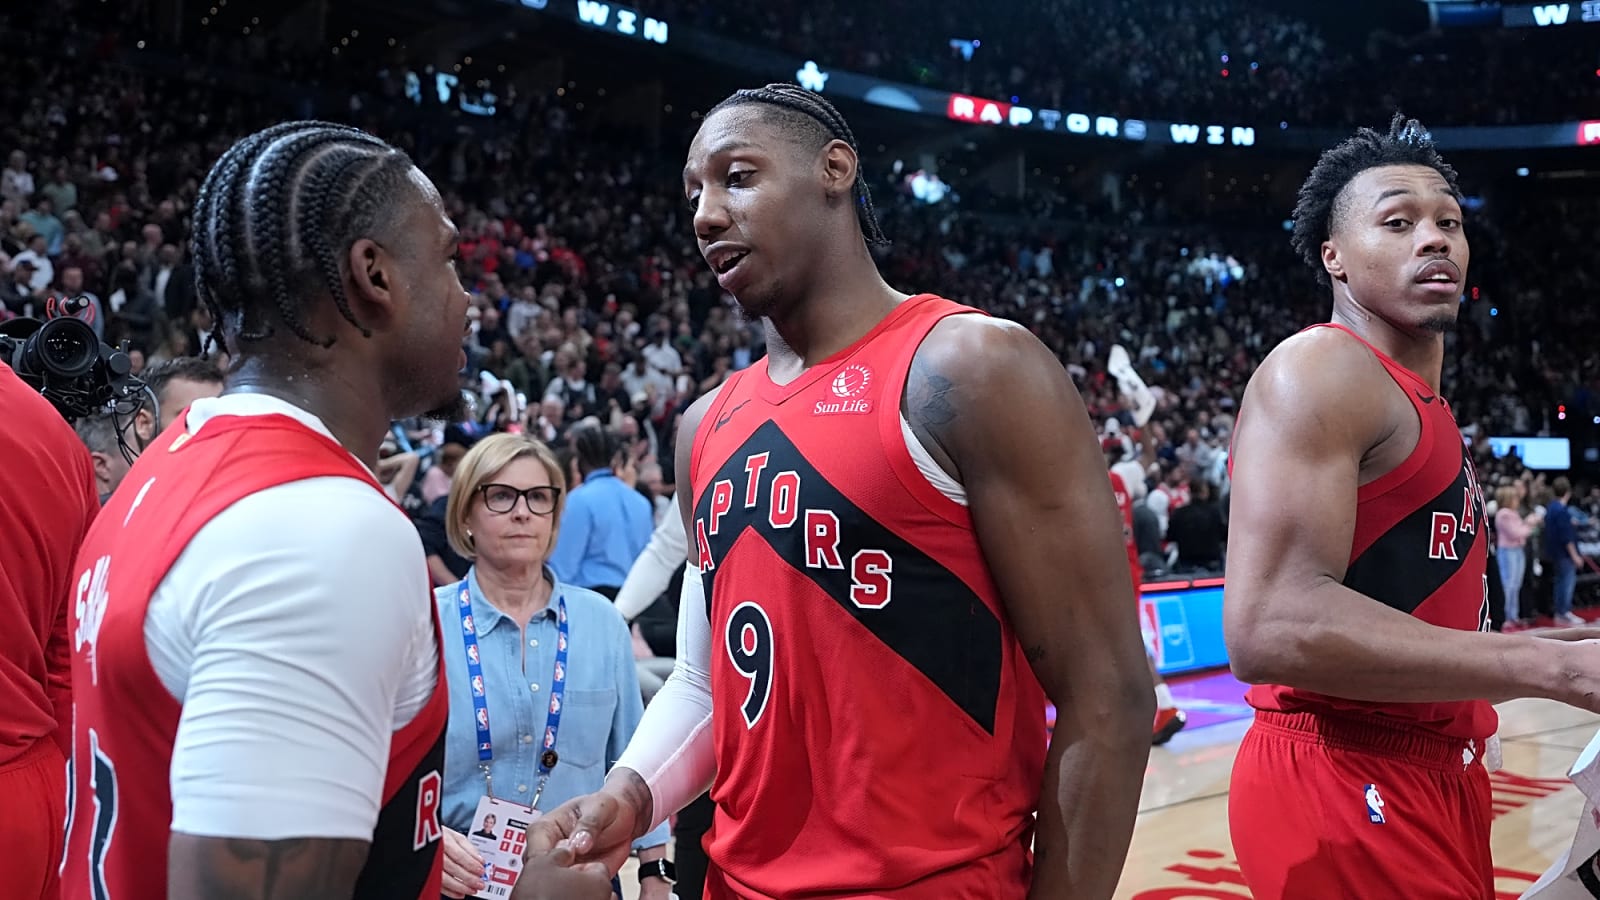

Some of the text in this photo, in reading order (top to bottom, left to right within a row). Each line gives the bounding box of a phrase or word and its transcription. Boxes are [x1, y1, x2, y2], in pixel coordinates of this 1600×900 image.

[577, 0, 669, 44] WIN
[953, 97, 1256, 146] RAPTORS WIN
[814, 400, 869, 414] Sun Life
[725, 600, 774, 730] 9
